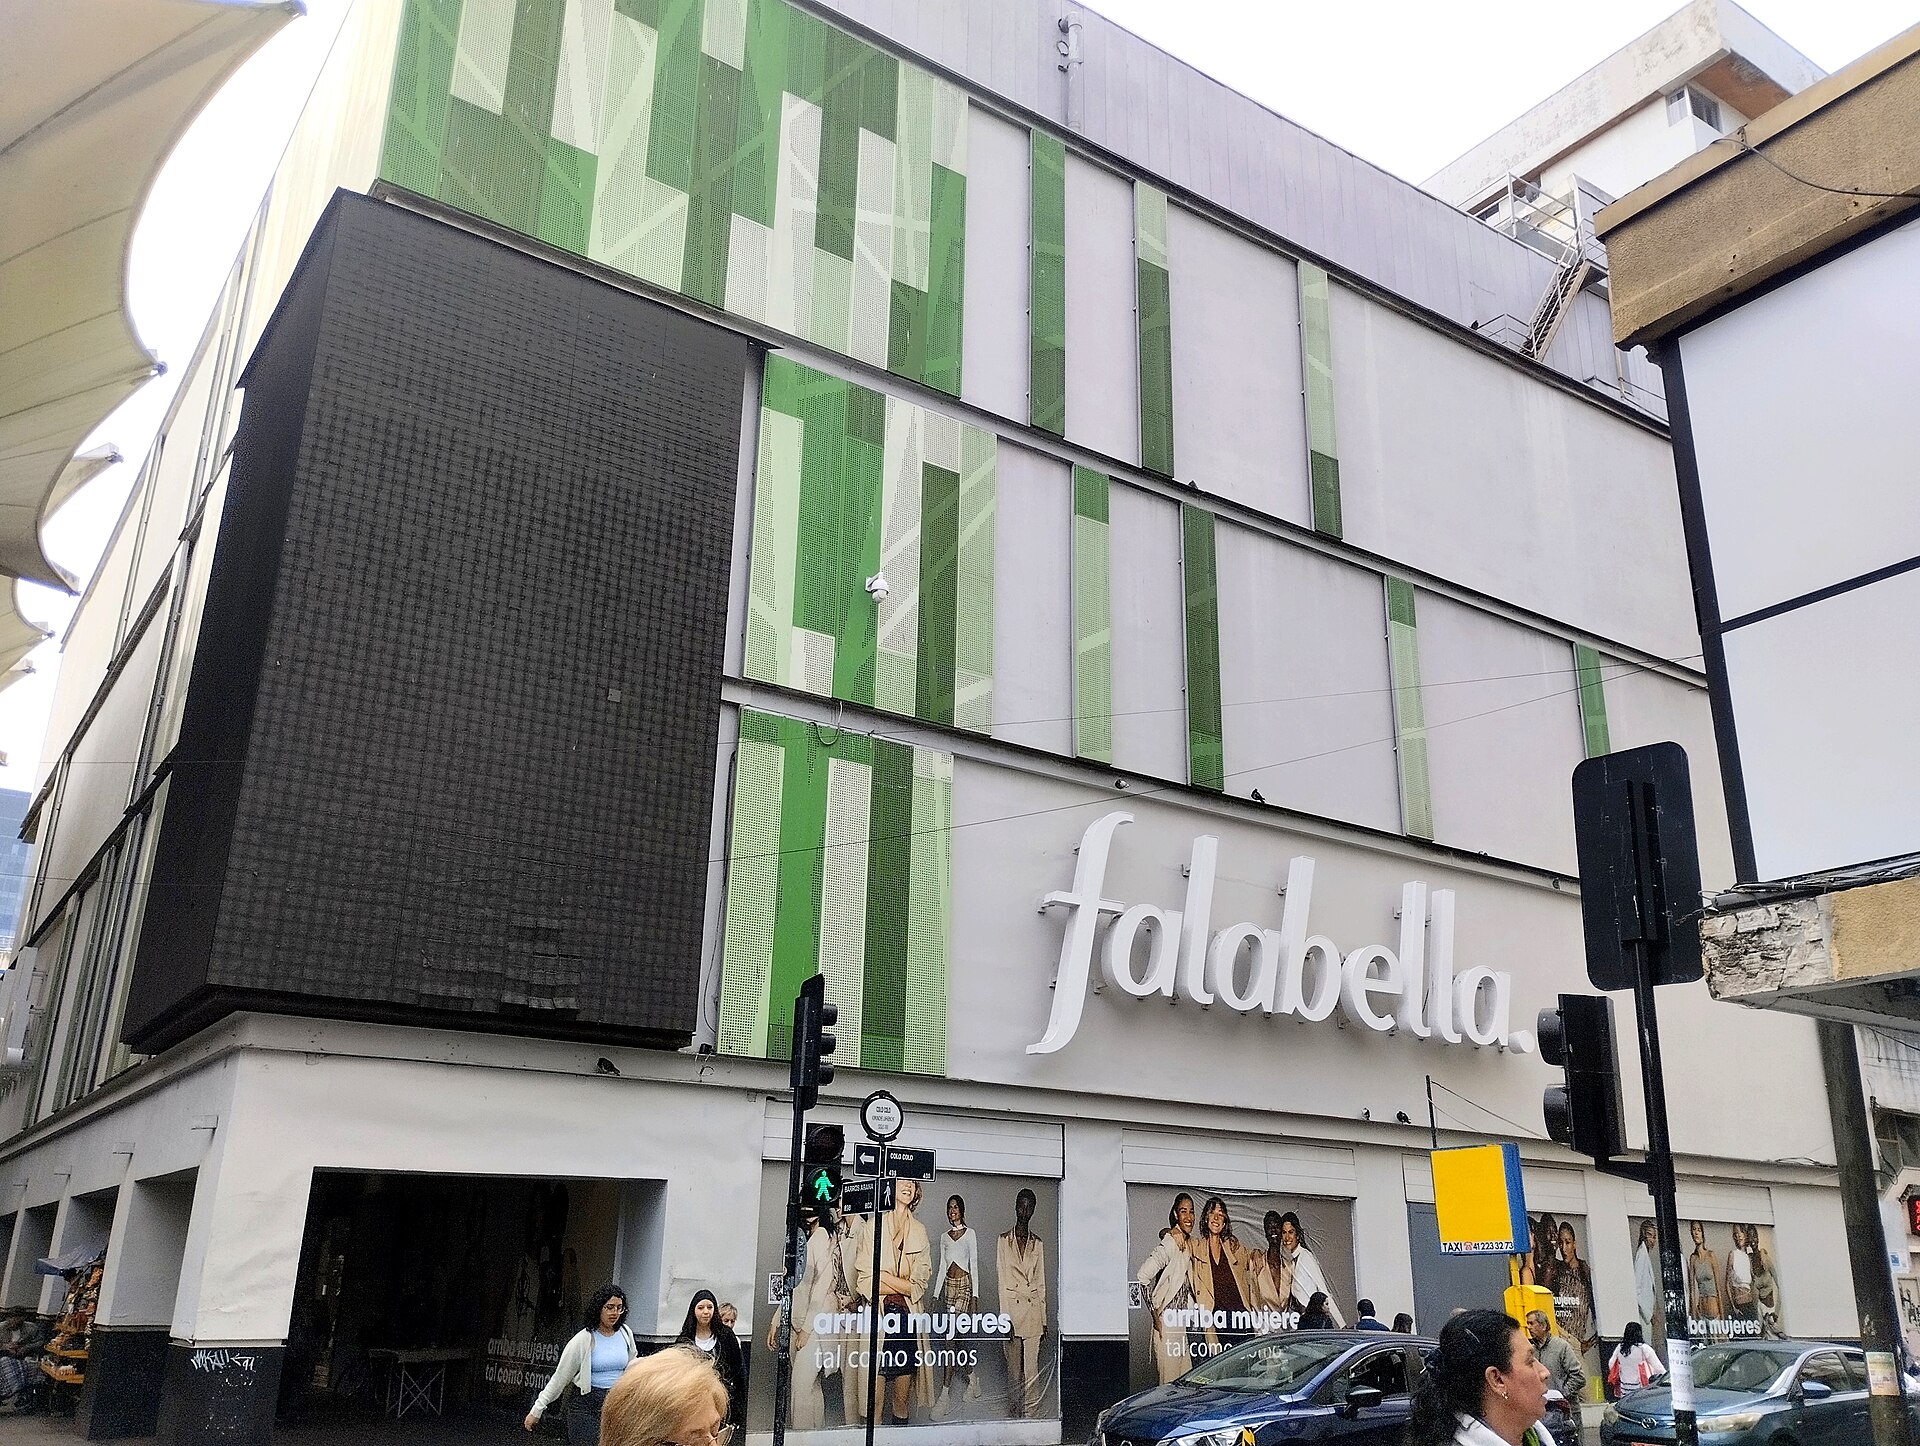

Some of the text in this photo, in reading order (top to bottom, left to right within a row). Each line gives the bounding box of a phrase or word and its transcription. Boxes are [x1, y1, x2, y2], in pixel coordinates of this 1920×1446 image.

[890, 1152, 913, 1161] COLO COLO
[1442, 1242, 1463, 1253] TAXI
[907, 1306, 1012, 1341] mujeres
[1163, 1303, 1300, 1334] arriba mujere
[1709, 1315, 1762, 1339] mujeres
[517, 1337, 560, 1365] mujeres
[815, 1344, 842, 1369] tal
[914, 1349, 978, 1367] somos
[1165, 1337, 1186, 1357] tal
[485, 1362, 498, 1382] tal
[497, 1366, 523, 1386] como
